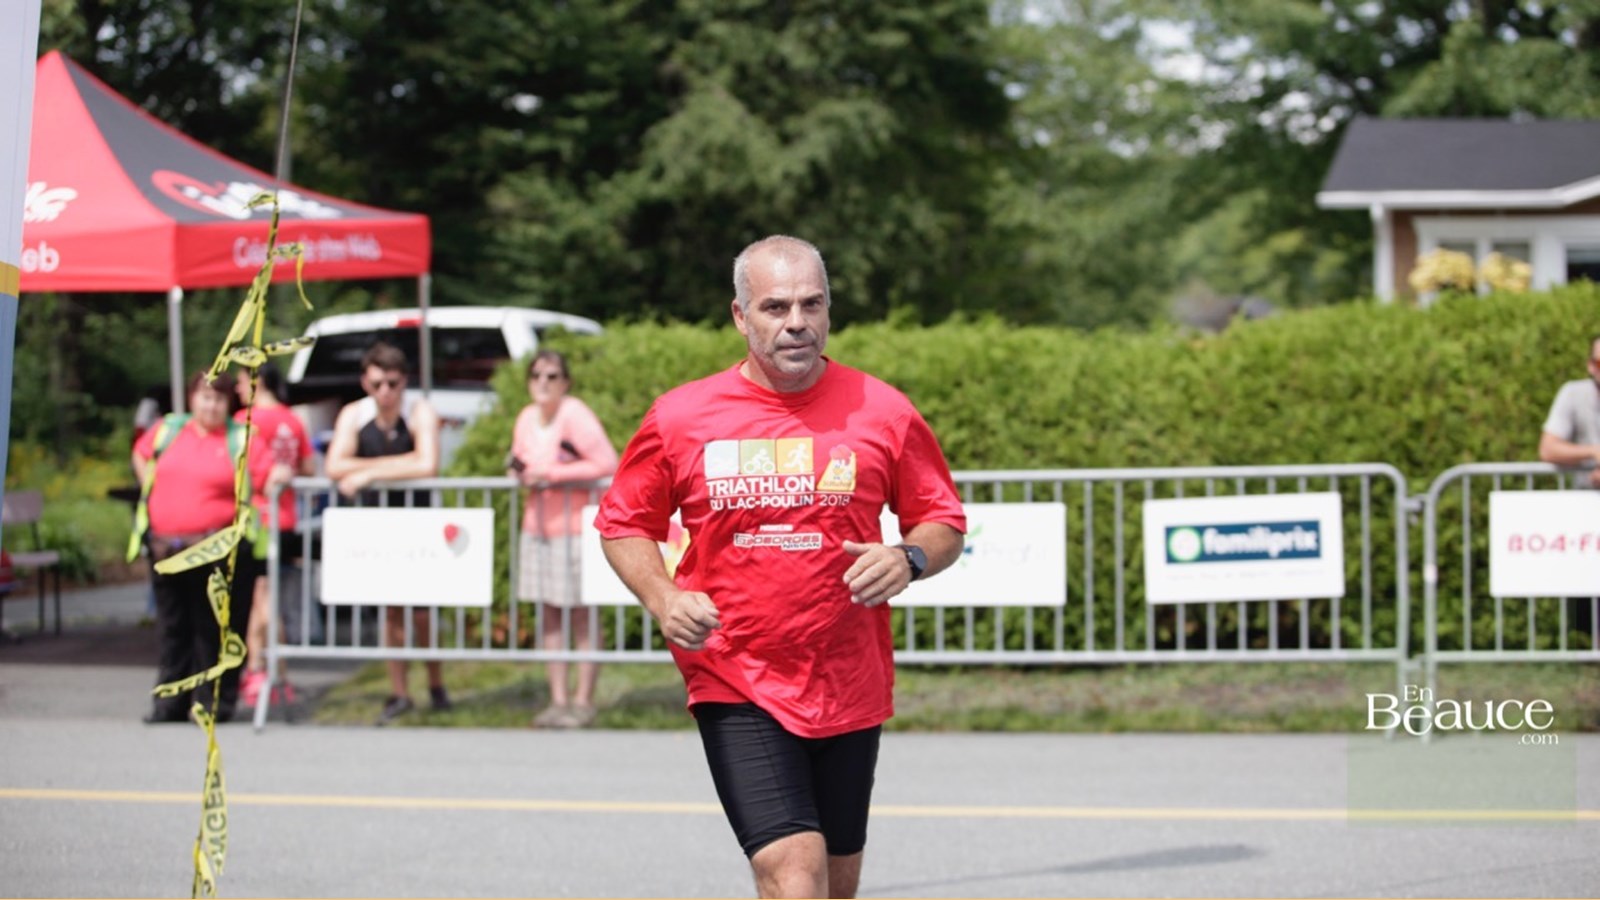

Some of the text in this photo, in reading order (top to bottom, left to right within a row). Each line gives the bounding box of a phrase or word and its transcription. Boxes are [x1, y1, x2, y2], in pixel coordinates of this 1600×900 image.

[21, 241, 60, 273] eb
[706, 475, 814, 496] TRIATHLON
[727, 494, 814, 510] LAC-POULIN
[819, 494, 851, 507] 2018
[1202, 525, 1318, 558] familiprix
[1508, 533, 1600, 553] BOA-F
